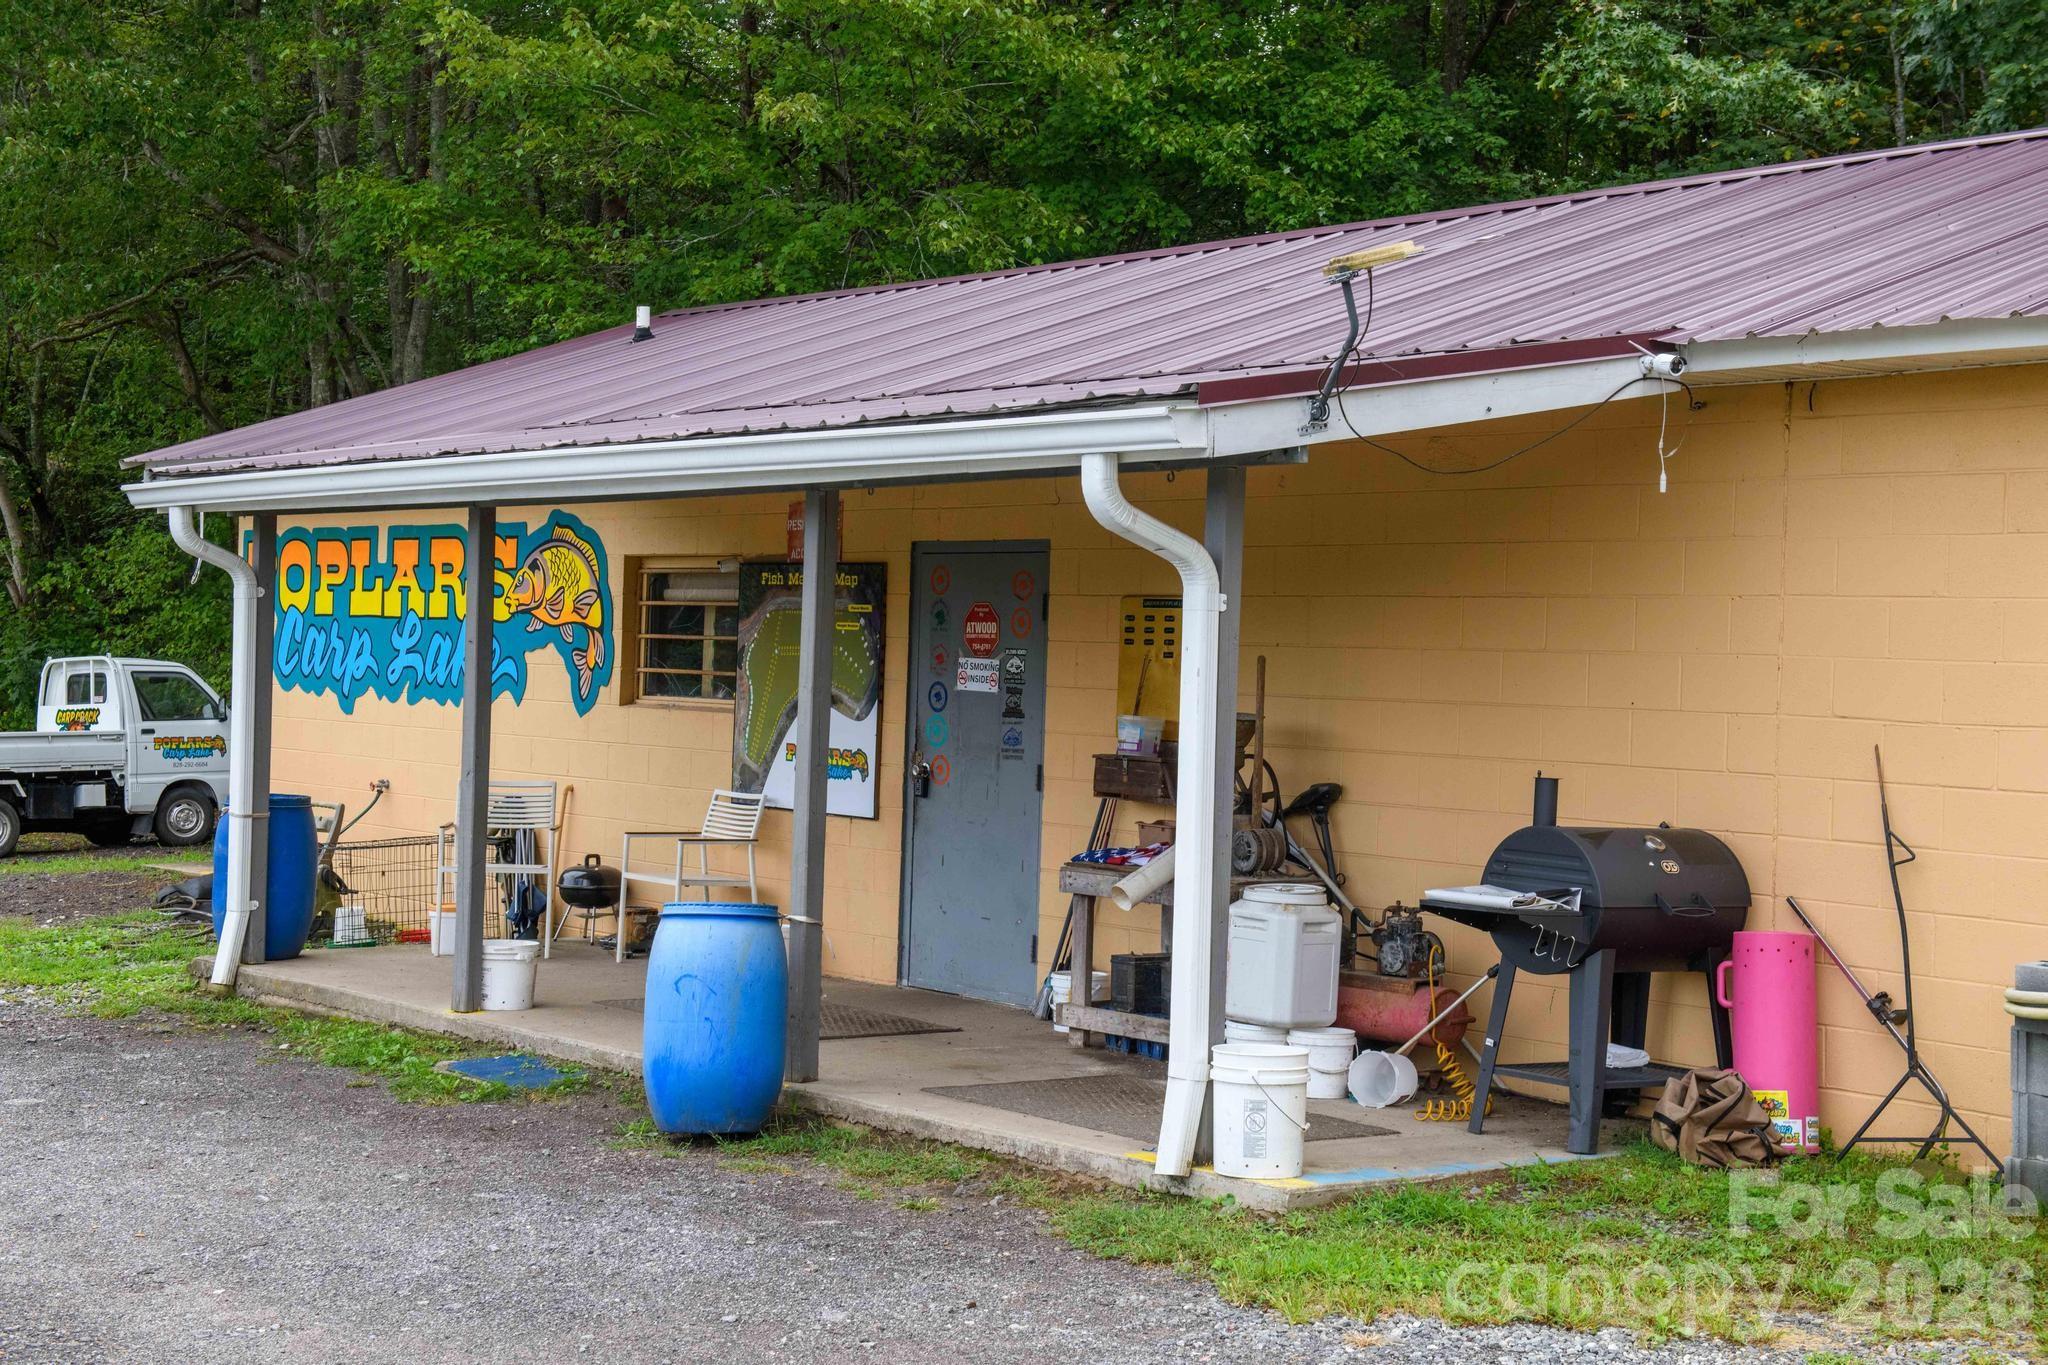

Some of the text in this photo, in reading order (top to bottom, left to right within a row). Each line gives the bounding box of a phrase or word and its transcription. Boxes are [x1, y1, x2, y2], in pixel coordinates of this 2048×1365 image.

[248, 536, 518, 622] OPLARS
[761, 572, 784, 585] Fish
[835, 573, 858, 588] Map
[966, 621, 997, 634] ATWOOD
[277, 604, 379, 698] Carp
[959, 661, 1000, 672] NO SMOKING
[967, 674, 990, 684] INSIDE
[154, 736, 212, 750] POPLARS
[163, 748, 186, 760] Carp
